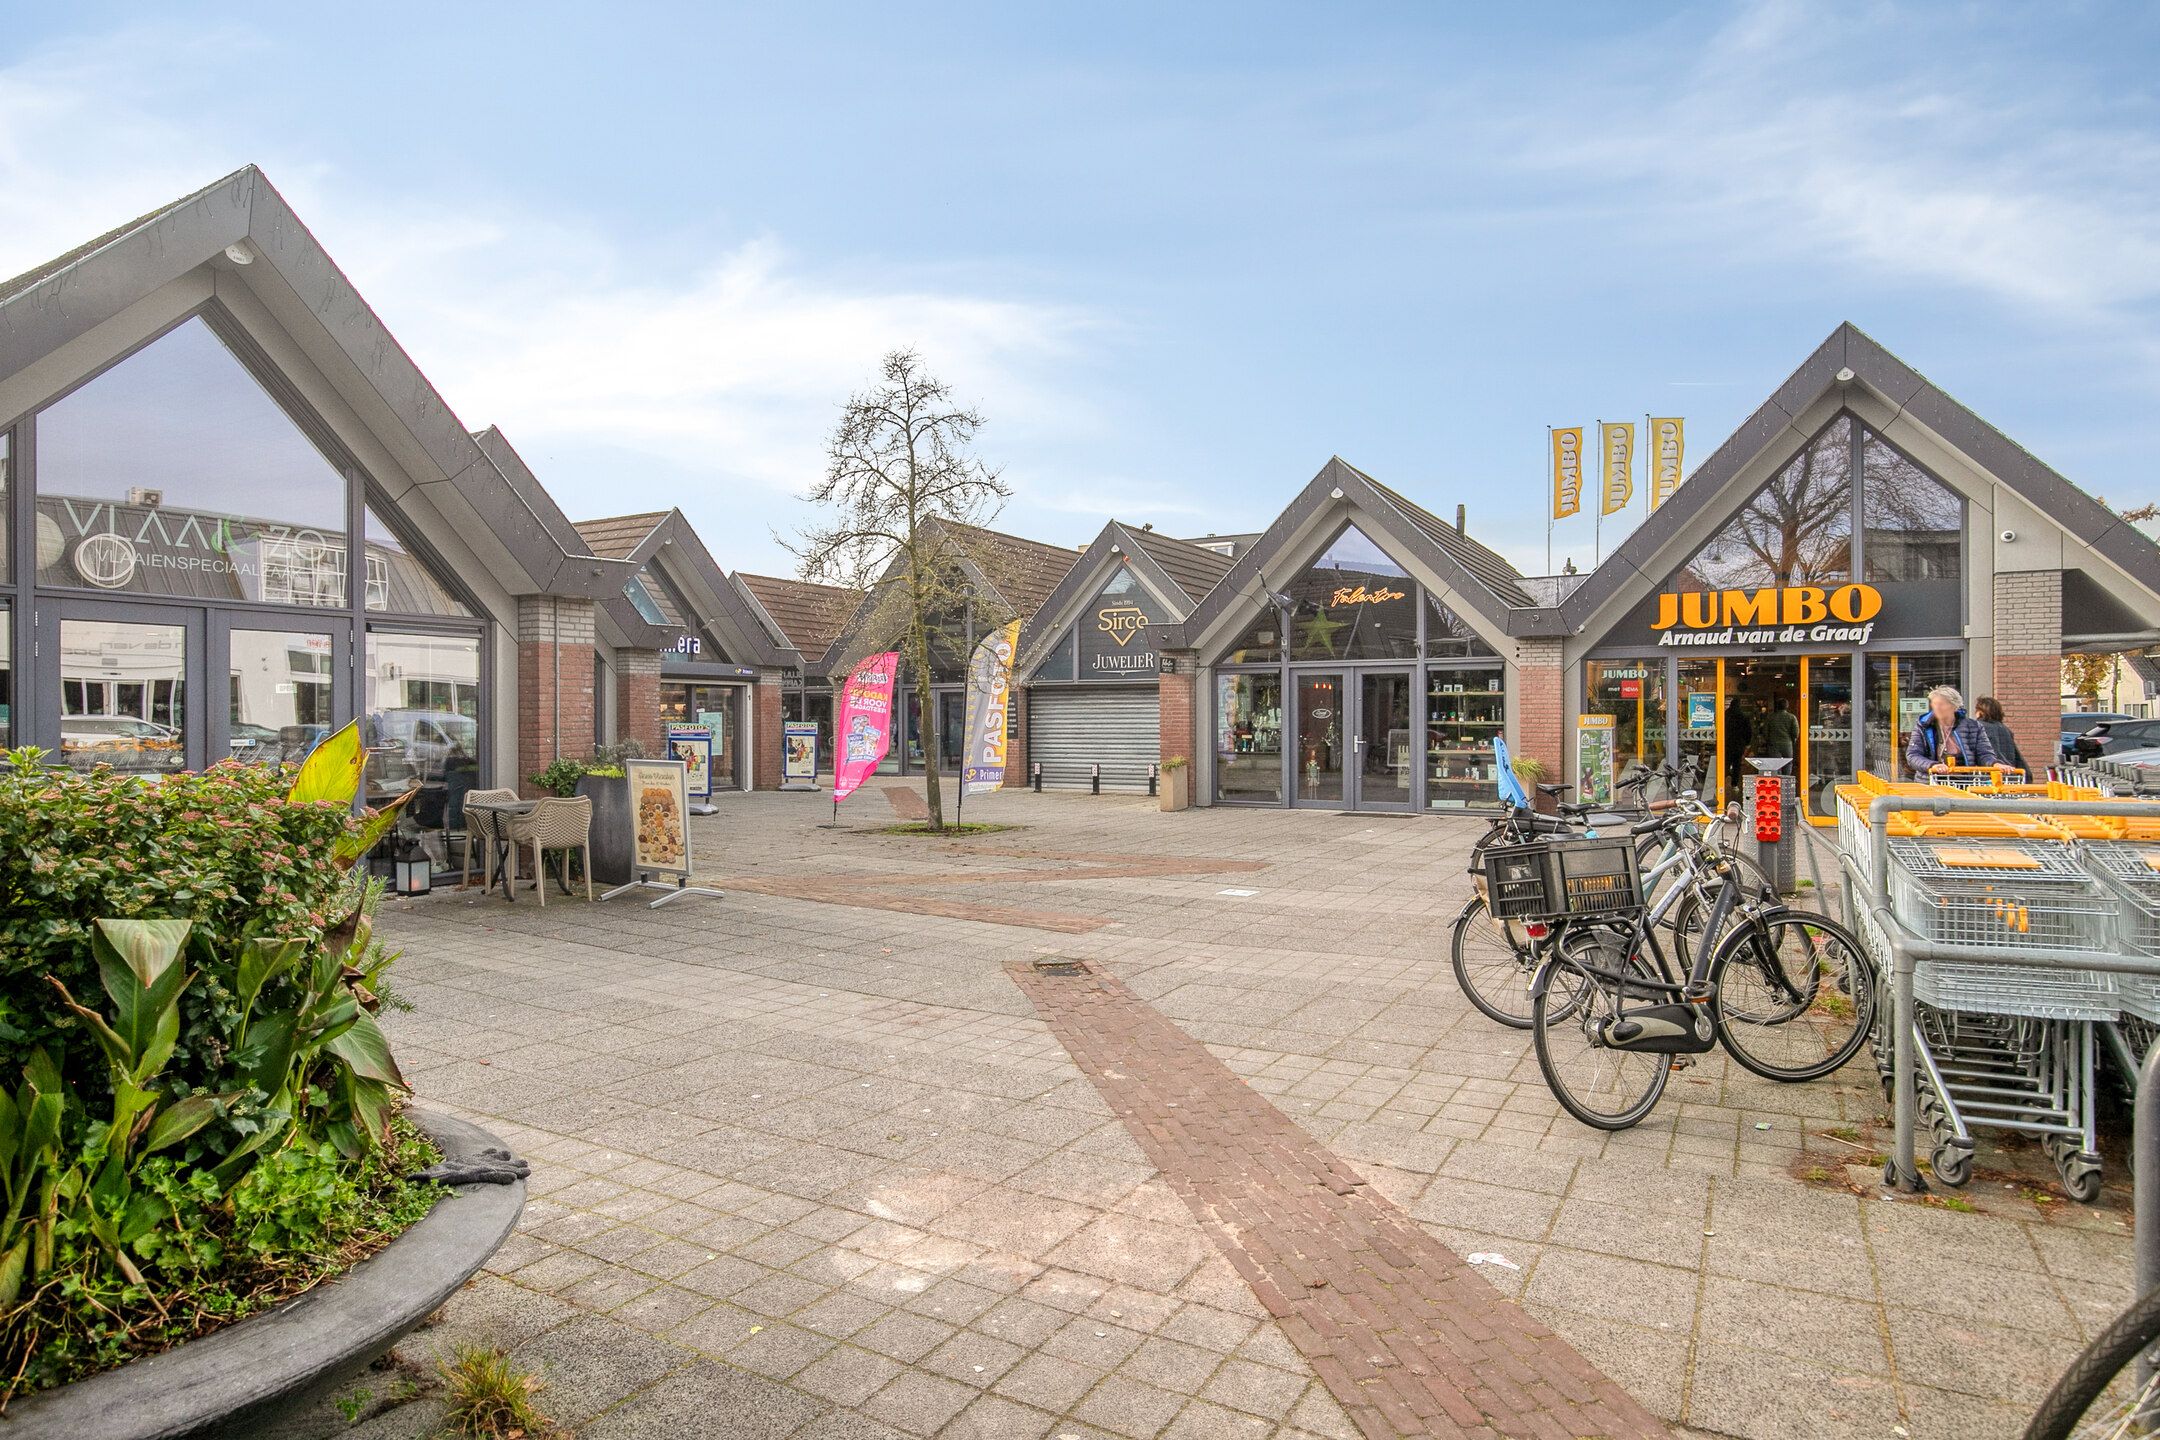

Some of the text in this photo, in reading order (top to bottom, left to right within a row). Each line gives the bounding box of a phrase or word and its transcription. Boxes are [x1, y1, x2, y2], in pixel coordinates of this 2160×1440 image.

[1560, 431, 1578, 512] JUMBO
[1610, 426, 1628, 508] JUMBO
[62, 497, 224, 551] VLAAI
[268, 523, 328, 563] ZO
[95, 545, 306, 579] VLAAIENSPECIAALZAAK
[1097, 607, 1149, 631] Sirco
[1650, 583, 1883, 630] JUMBO
[1658, 622, 1875, 646] Arnaud van de Graaf
[1092, 652, 1155, 670] JUWELIER
[1602, 669, 1649, 679] JUMBO
[1583, 717, 1609, 725] JUMBO
